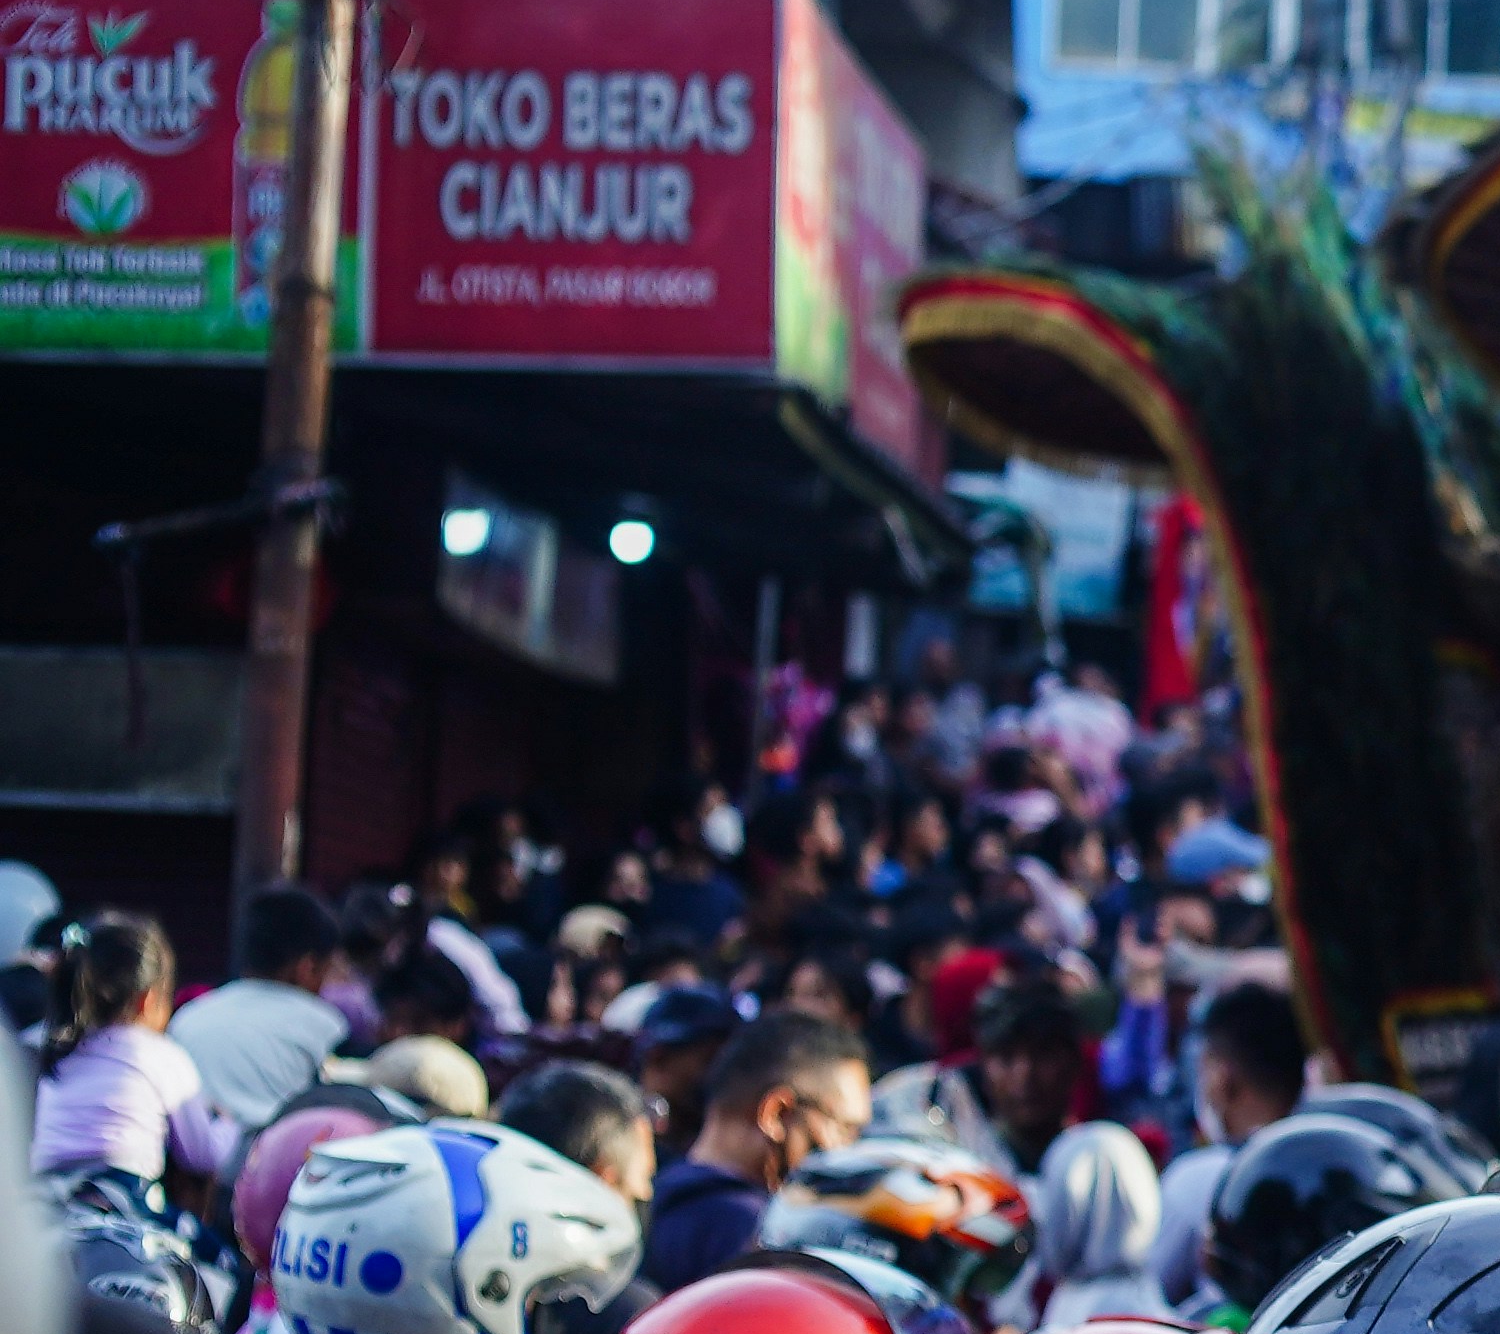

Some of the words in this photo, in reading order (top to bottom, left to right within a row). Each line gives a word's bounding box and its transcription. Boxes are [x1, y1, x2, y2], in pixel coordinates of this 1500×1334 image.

[390, 69, 553, 151] TOKO
[562, 69, 753, 155] BERAS
[439, 160, 692, 243] CIANJUR
[274, 1226, 348, 1288] LISI
